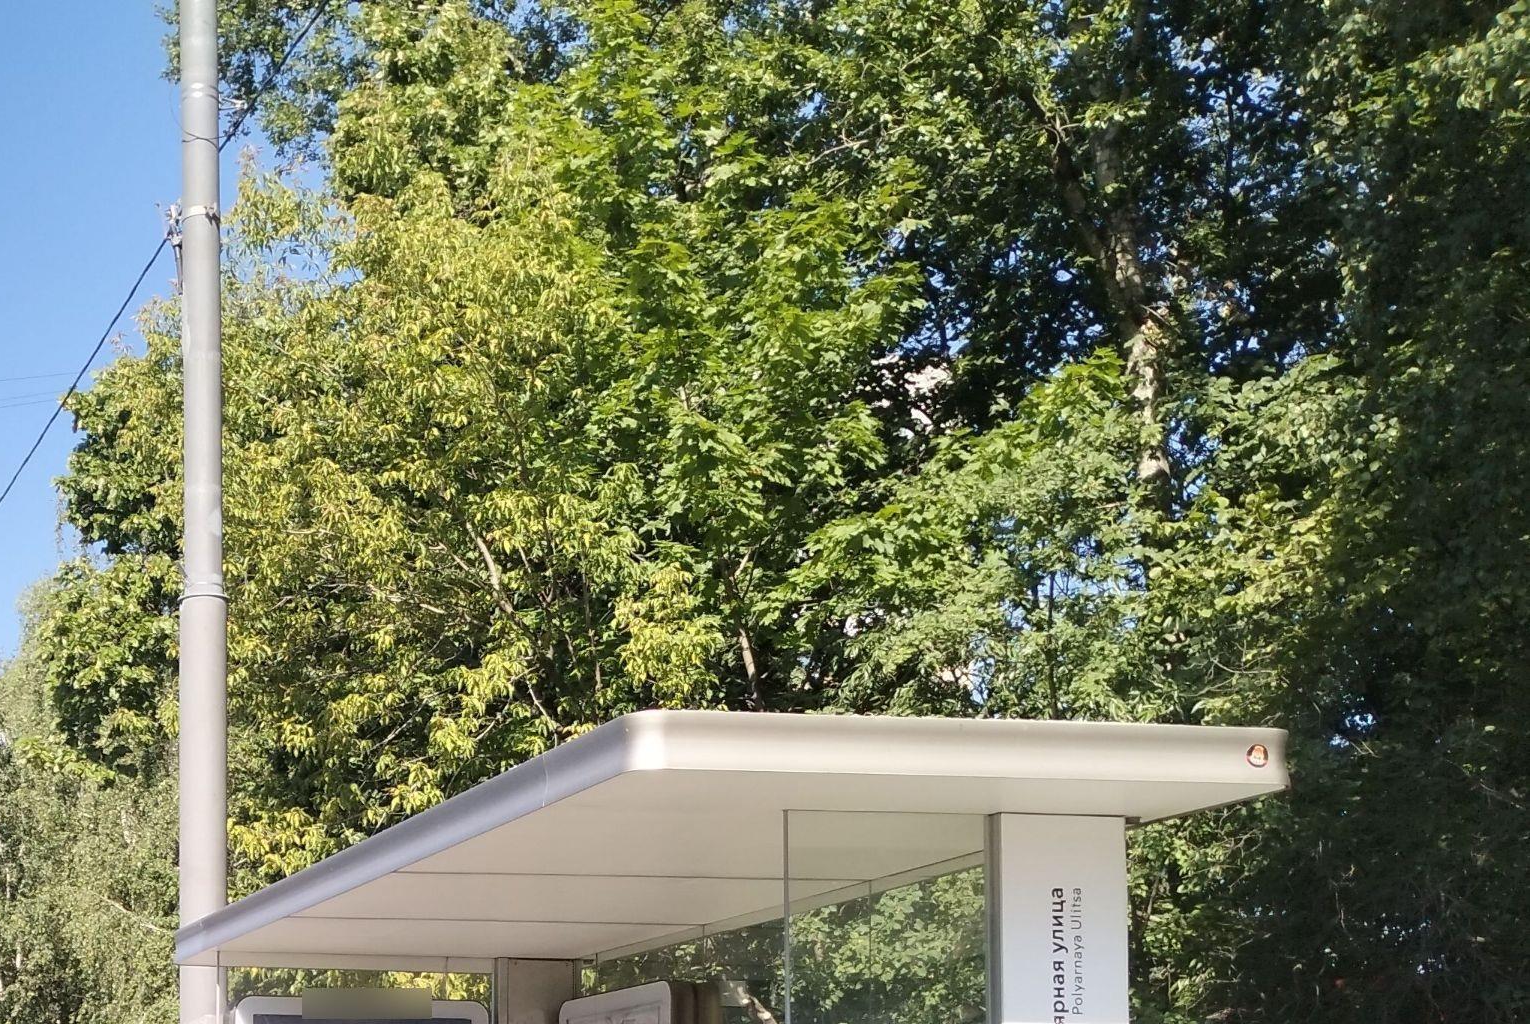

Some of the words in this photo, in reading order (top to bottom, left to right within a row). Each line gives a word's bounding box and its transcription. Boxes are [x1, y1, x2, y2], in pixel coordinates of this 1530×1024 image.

[1051, 887, 1068, 953] улица
[1070, 888, 1082, 930] Ulitsa
[1072, 935, 1085, 1015] Polyarnaya
